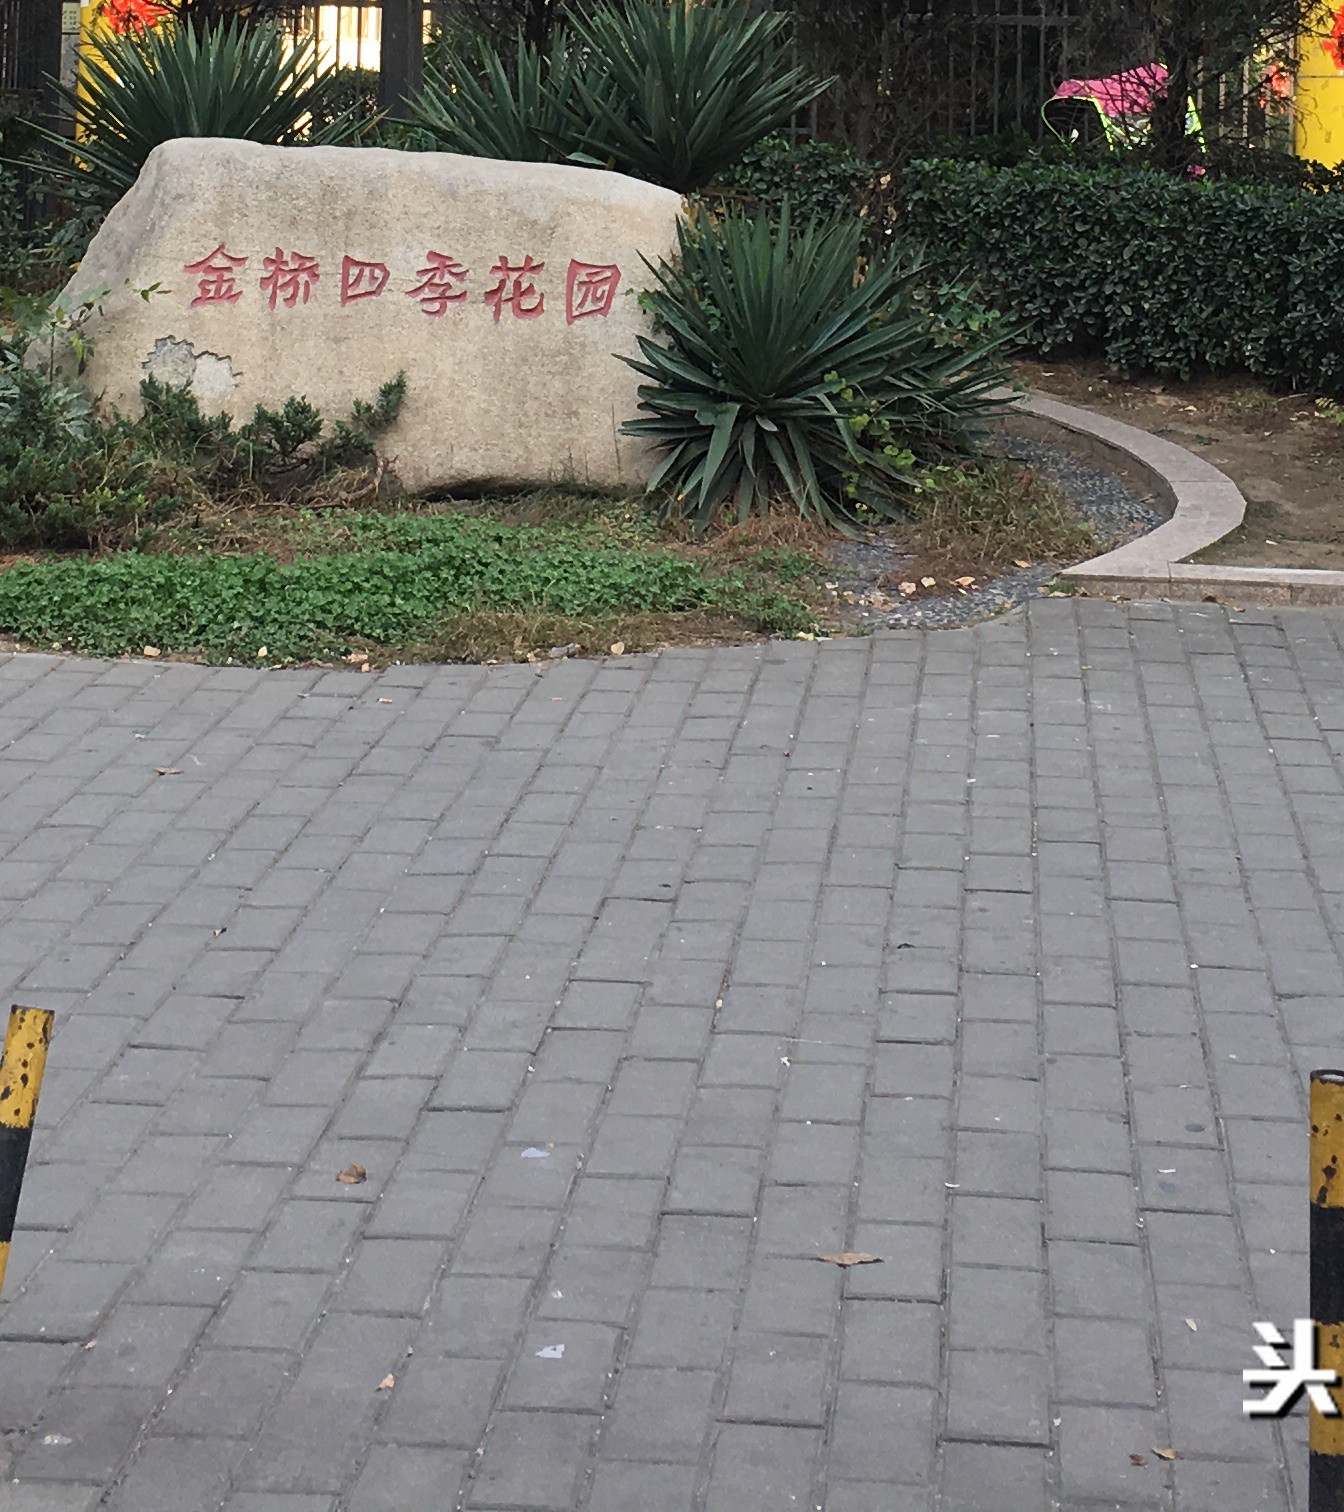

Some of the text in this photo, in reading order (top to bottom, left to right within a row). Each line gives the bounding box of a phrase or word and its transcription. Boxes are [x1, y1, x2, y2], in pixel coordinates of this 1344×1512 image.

[183, 244, 623, 326] 金桥四季花园
